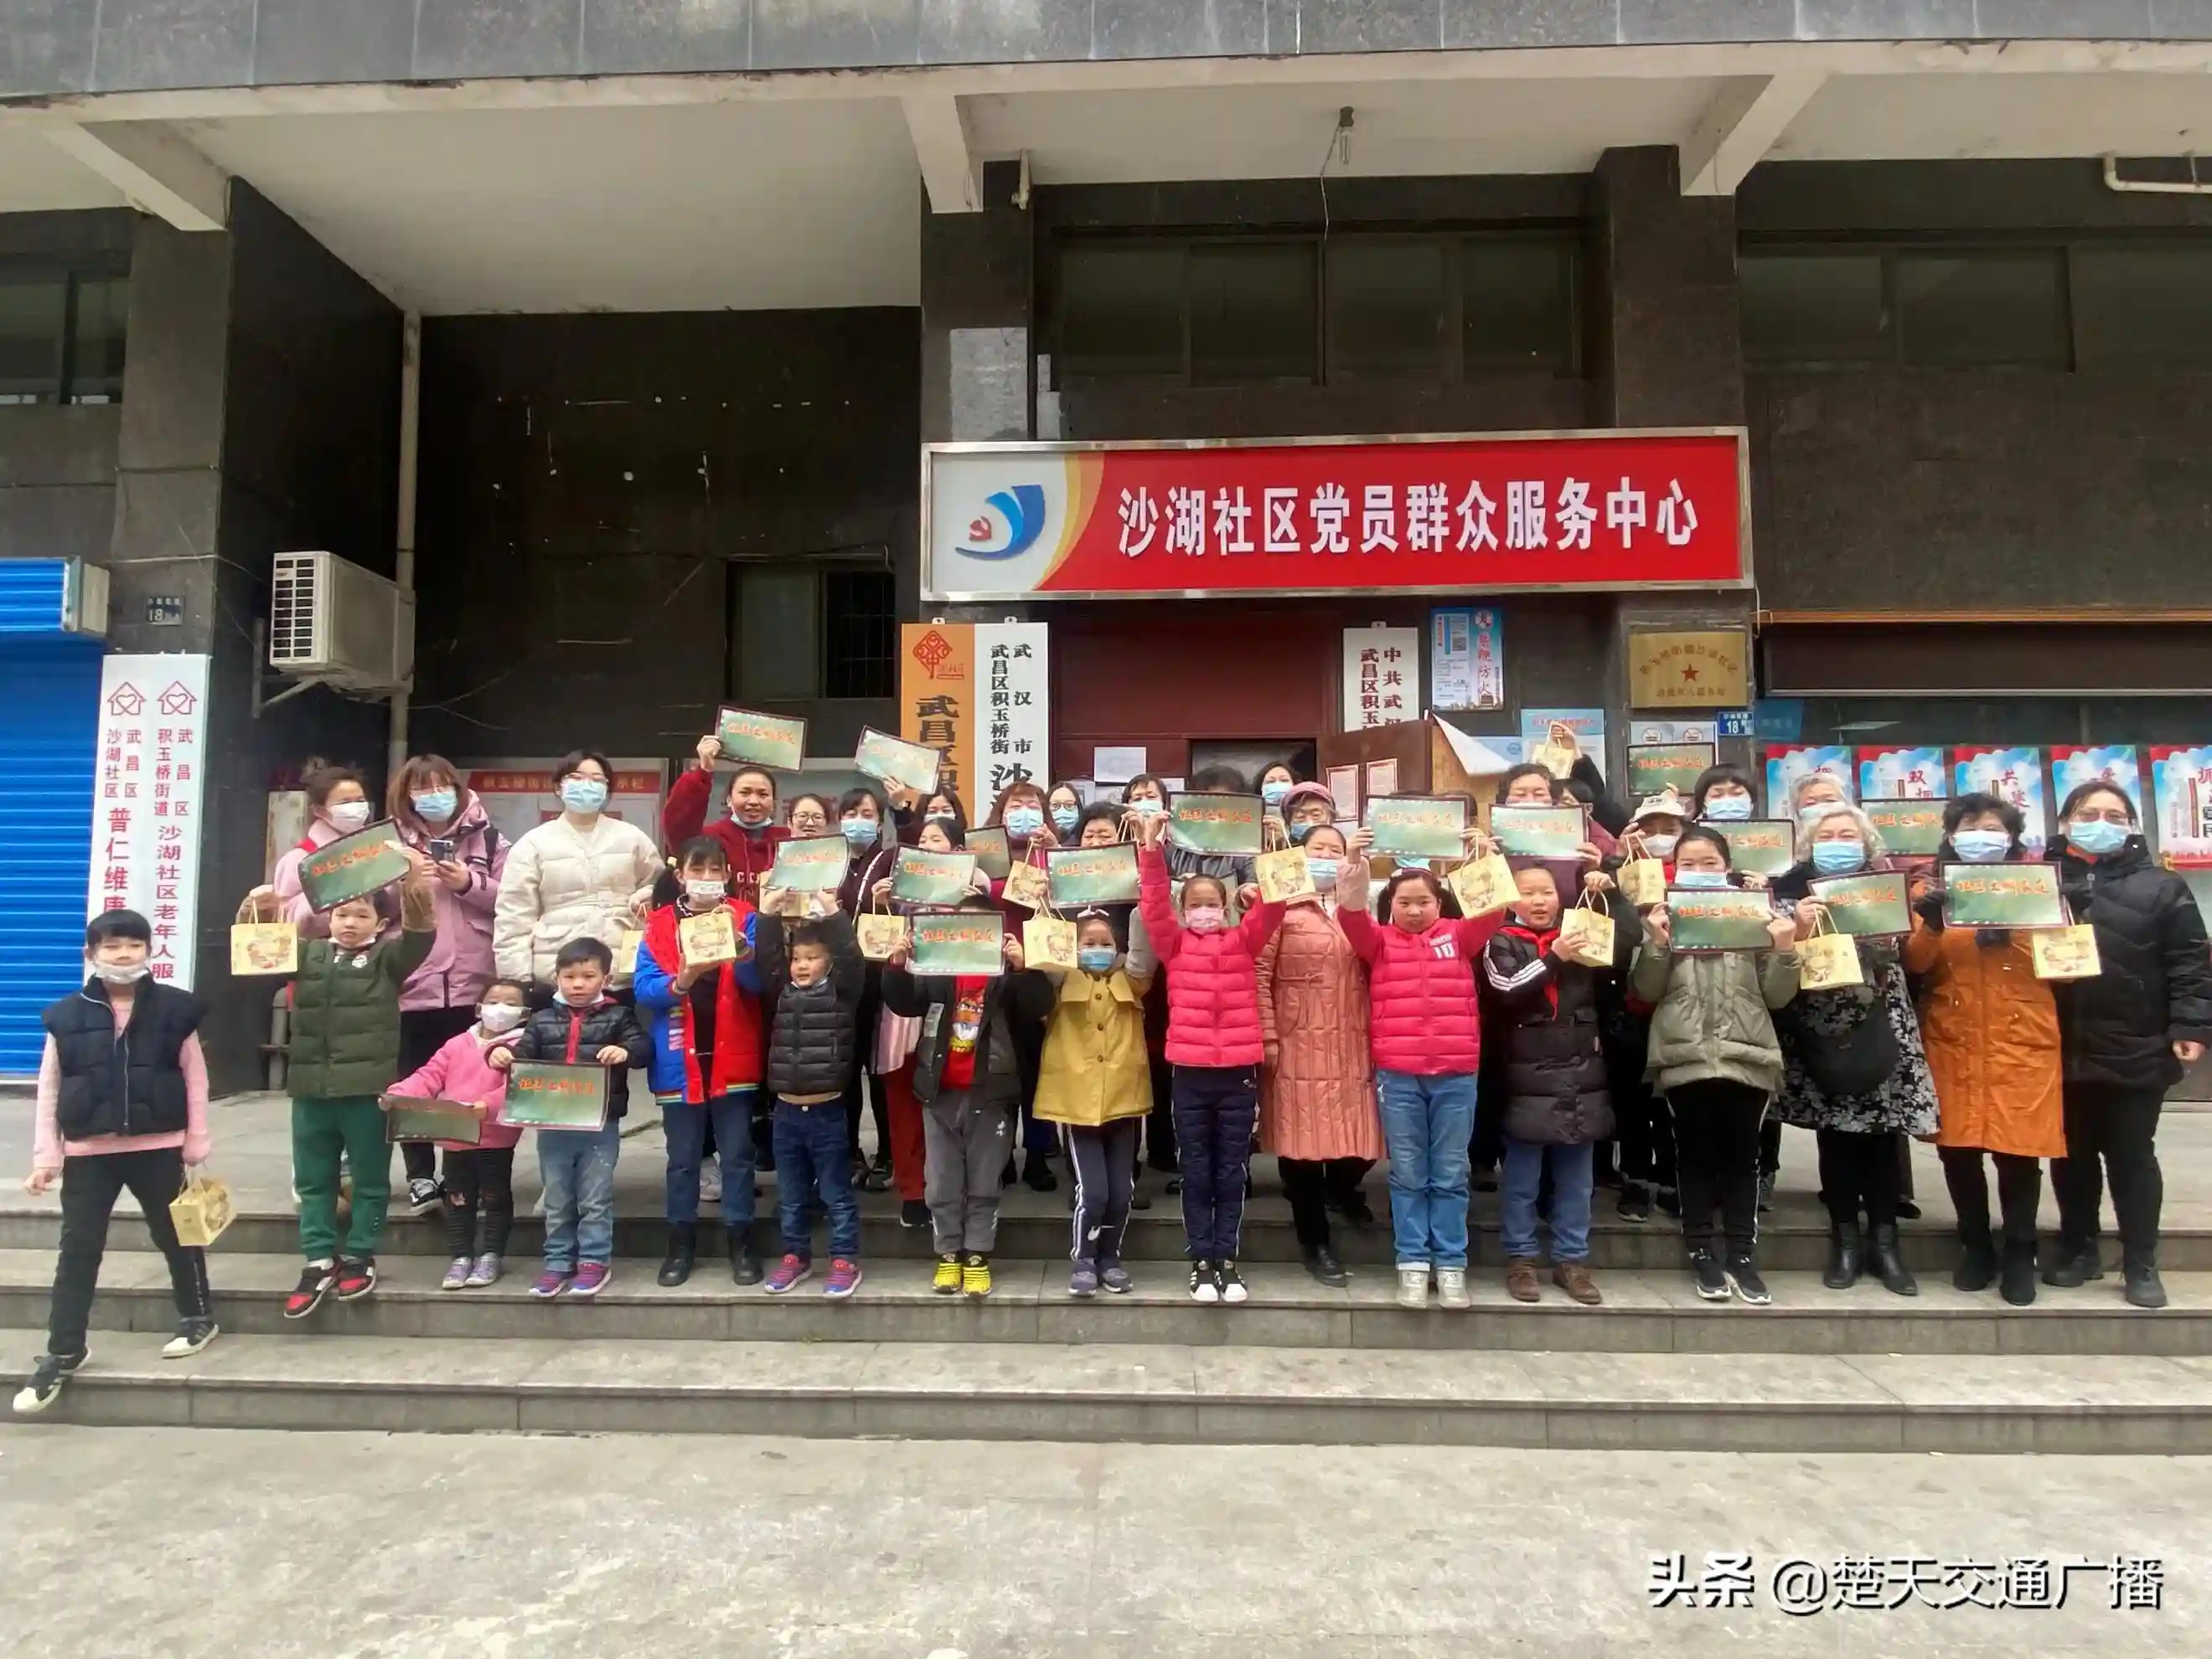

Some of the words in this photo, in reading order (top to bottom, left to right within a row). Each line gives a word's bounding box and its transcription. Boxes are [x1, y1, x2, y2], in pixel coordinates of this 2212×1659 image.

[1118, 476, 1698, 558] 沙湖社区党员群众服务中心
[990, 643, 1010, 754] 武昌区积玉桥街
[1013, 643, 1032, 754] 武汉市
[1361, 648, 1380, 729] 武昌区积玉
[1726, 720, 1739, 734] 18
[105, 728, 121, 798] 沙湖社区
[125, 728, 142, 798] 武昌区
[153, 728, 173, 816] 积玉桥街道
[174, 728, 194, 816] 武昌区
[152, 824, 183, 979] 沙湖社区老年人服
[1434, 943, 1455, 959] 10
